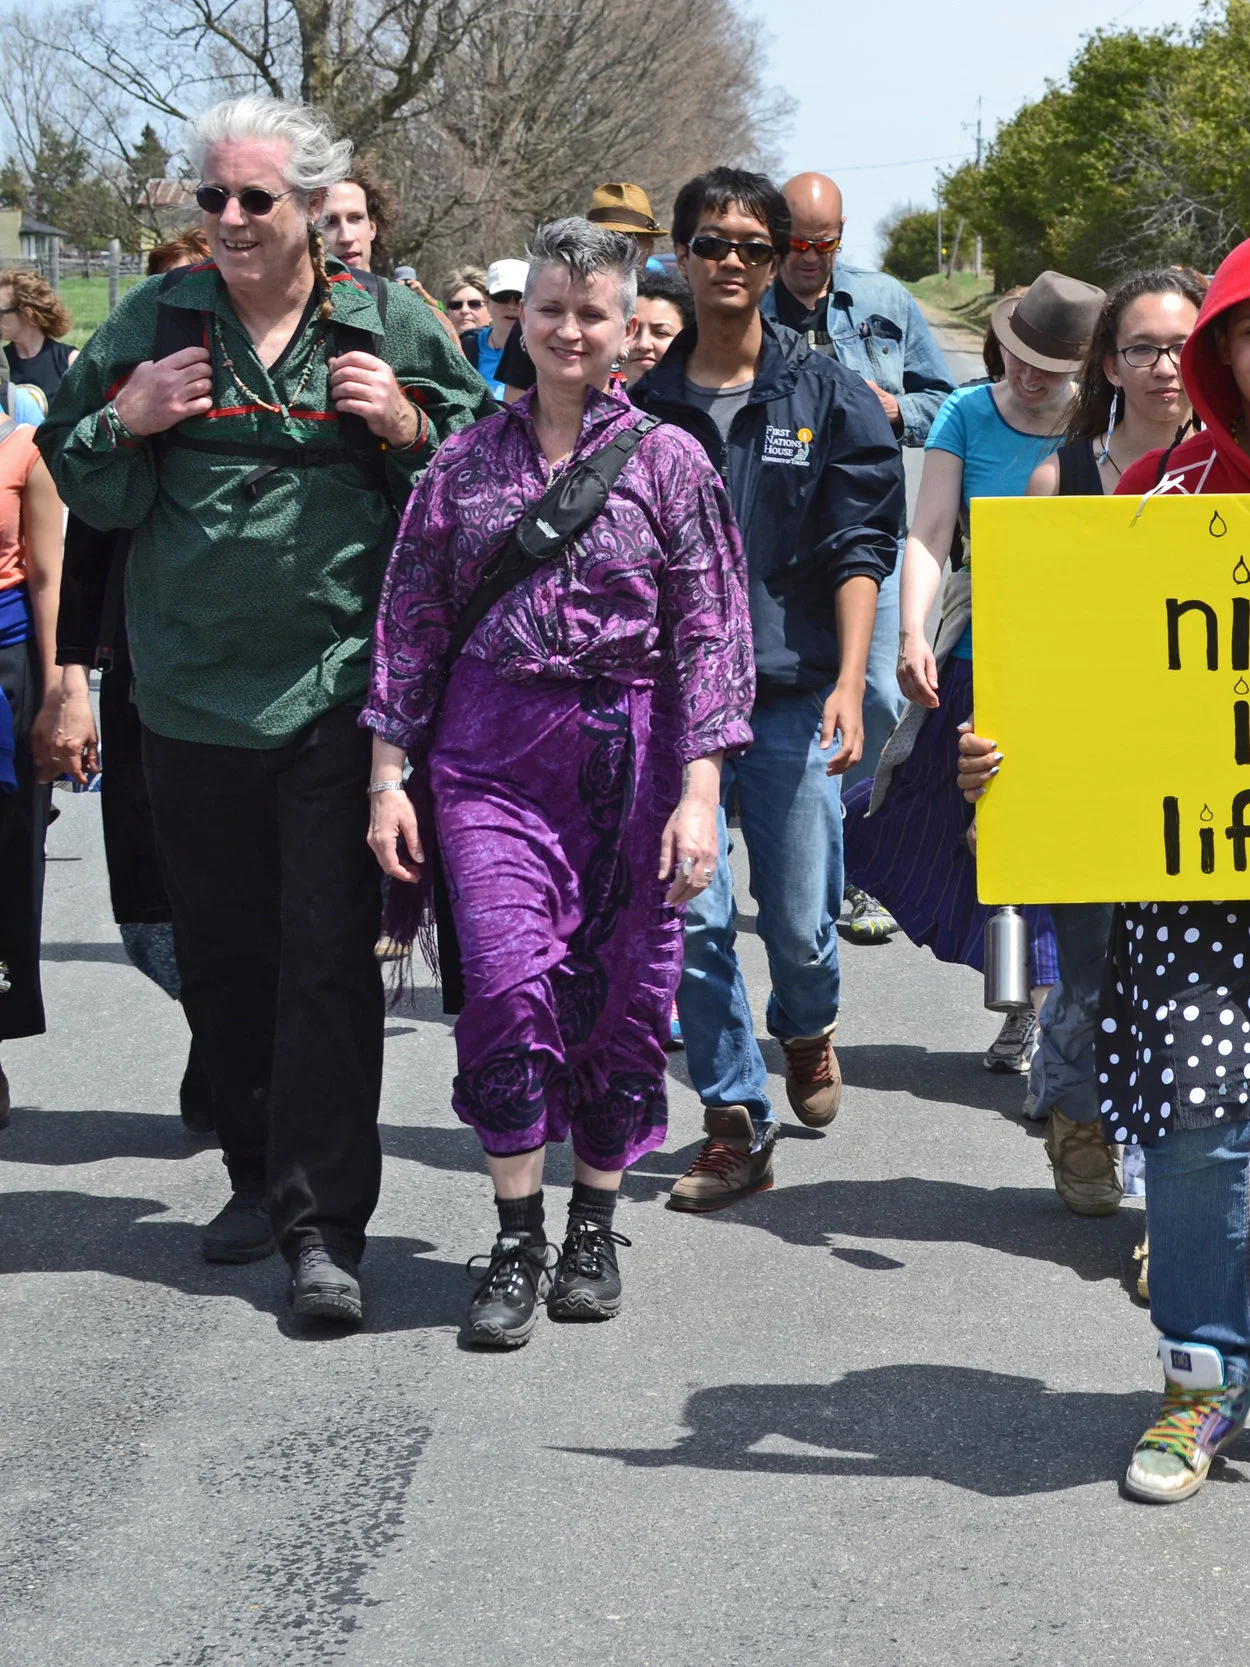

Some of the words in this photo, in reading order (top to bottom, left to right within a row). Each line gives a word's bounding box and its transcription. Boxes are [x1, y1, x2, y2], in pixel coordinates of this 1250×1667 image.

[765, 425, 791, 437] FIRST
[764, 434, 803, 449] NATIONS
[763, 444, 794, 457] HOUSE
